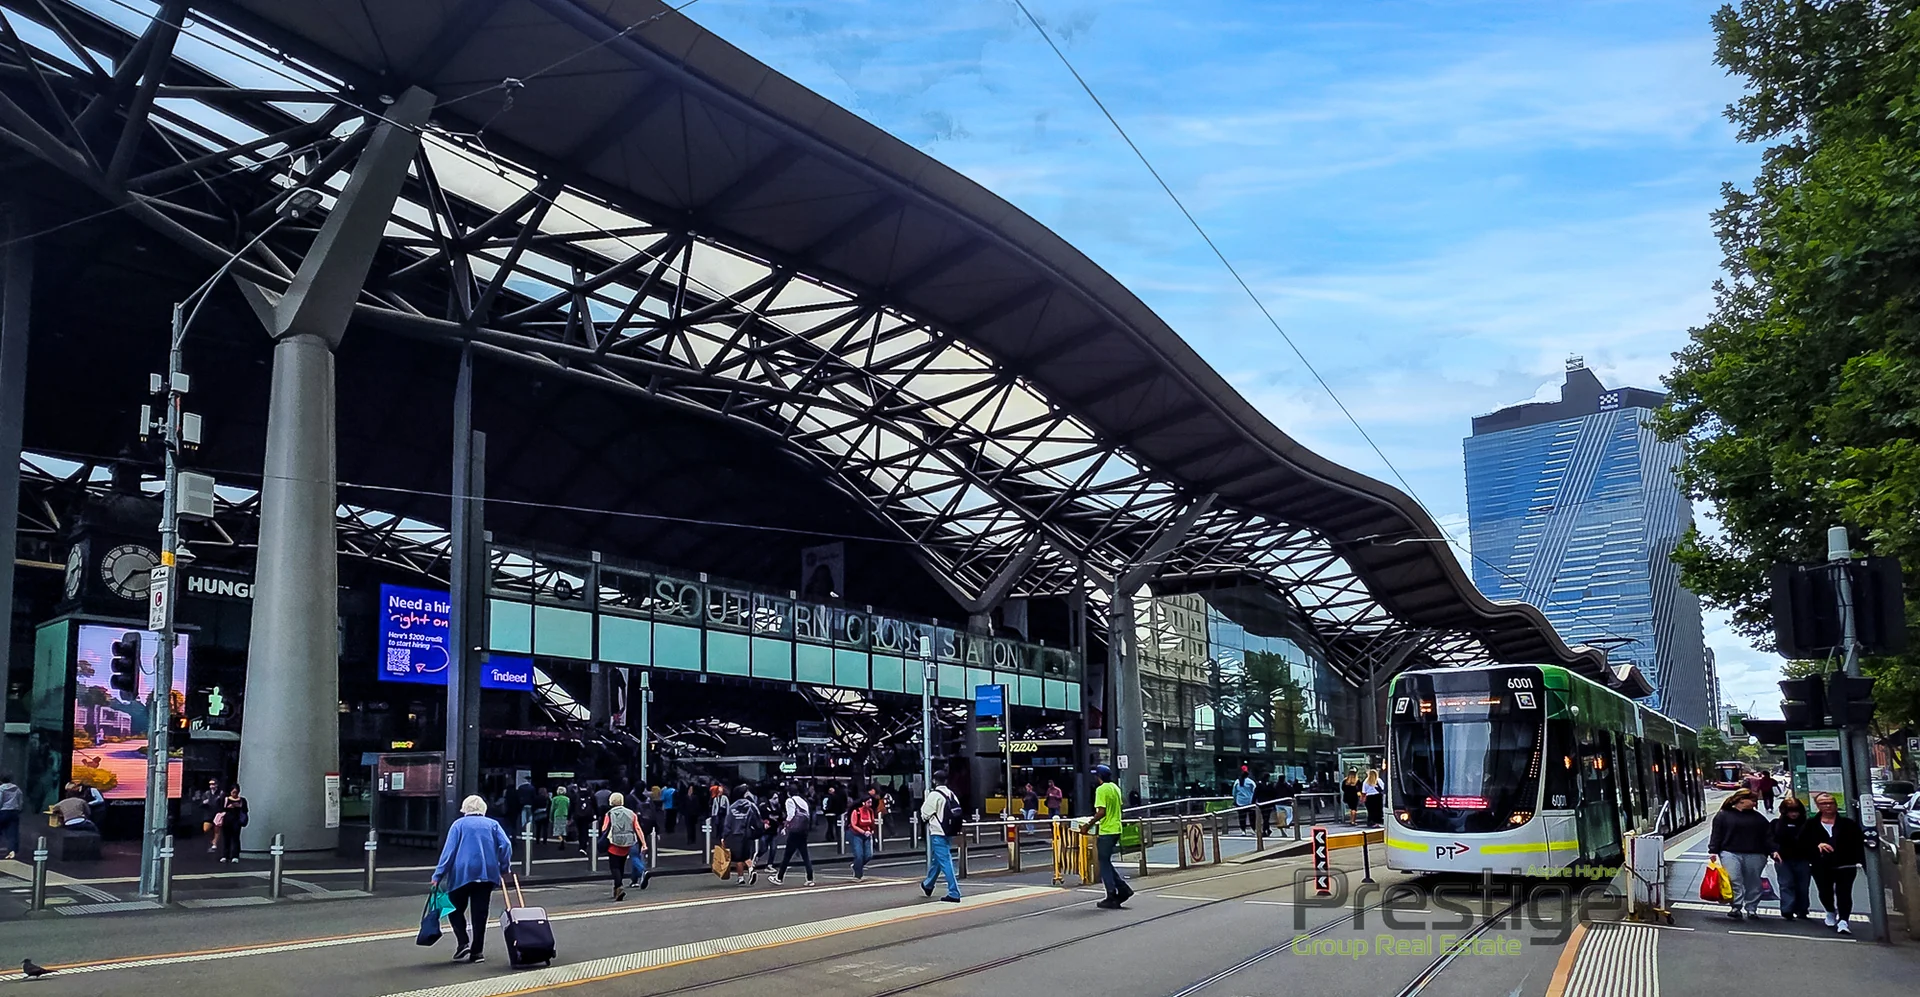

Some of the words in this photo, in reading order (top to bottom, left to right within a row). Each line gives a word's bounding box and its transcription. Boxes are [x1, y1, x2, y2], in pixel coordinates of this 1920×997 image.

[389, 595, 423, 610] Need
[424, 602, 432, 612] a
[390, 611, 430, 629] right
[388, 631, 408, 640] Here's
[408, 632, 425, 641] $200
[425, 635, 443, 643] credit
[396, 640, 411, 648] start
[412, 641, 430, 650] hiring
[943, 630, 1018, 669] STATON
[493, 670, 527, 683] indeed
[1507, 677, 1533, 689] 6001
[180, 718, 187, 728] 7
[1552, 795, 1567, 806] 6001
